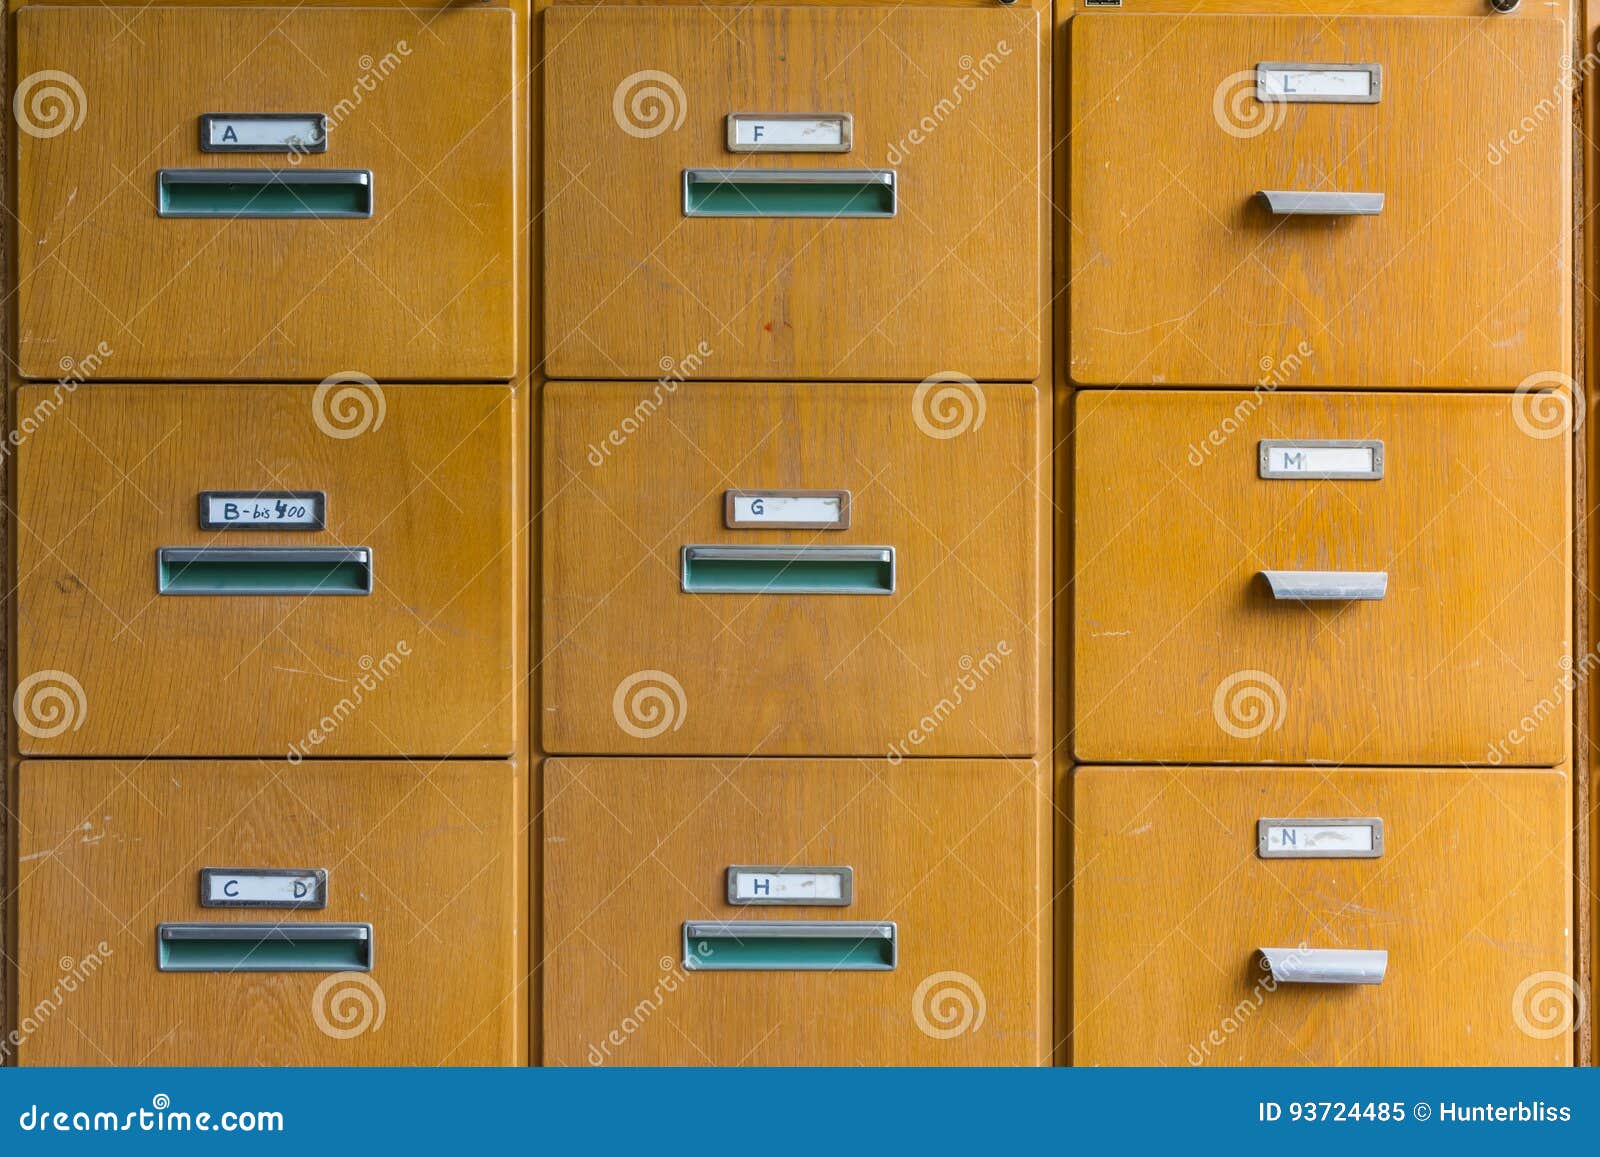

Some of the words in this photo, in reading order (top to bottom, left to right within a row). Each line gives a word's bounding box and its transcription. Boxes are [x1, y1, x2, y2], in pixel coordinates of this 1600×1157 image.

[1284, 74, 1297, 93] L
[221, 125, 238, 143] A
[754, 125, 765, 142] F
[1284, 452, 1302, 470] M
[750, 497, 764, 515] G
[1282, 828, 1297, 846] N
[223, 879, 240, 897] C
[293, 880, 308, 899] D
[754, 878, 770, 895] H
